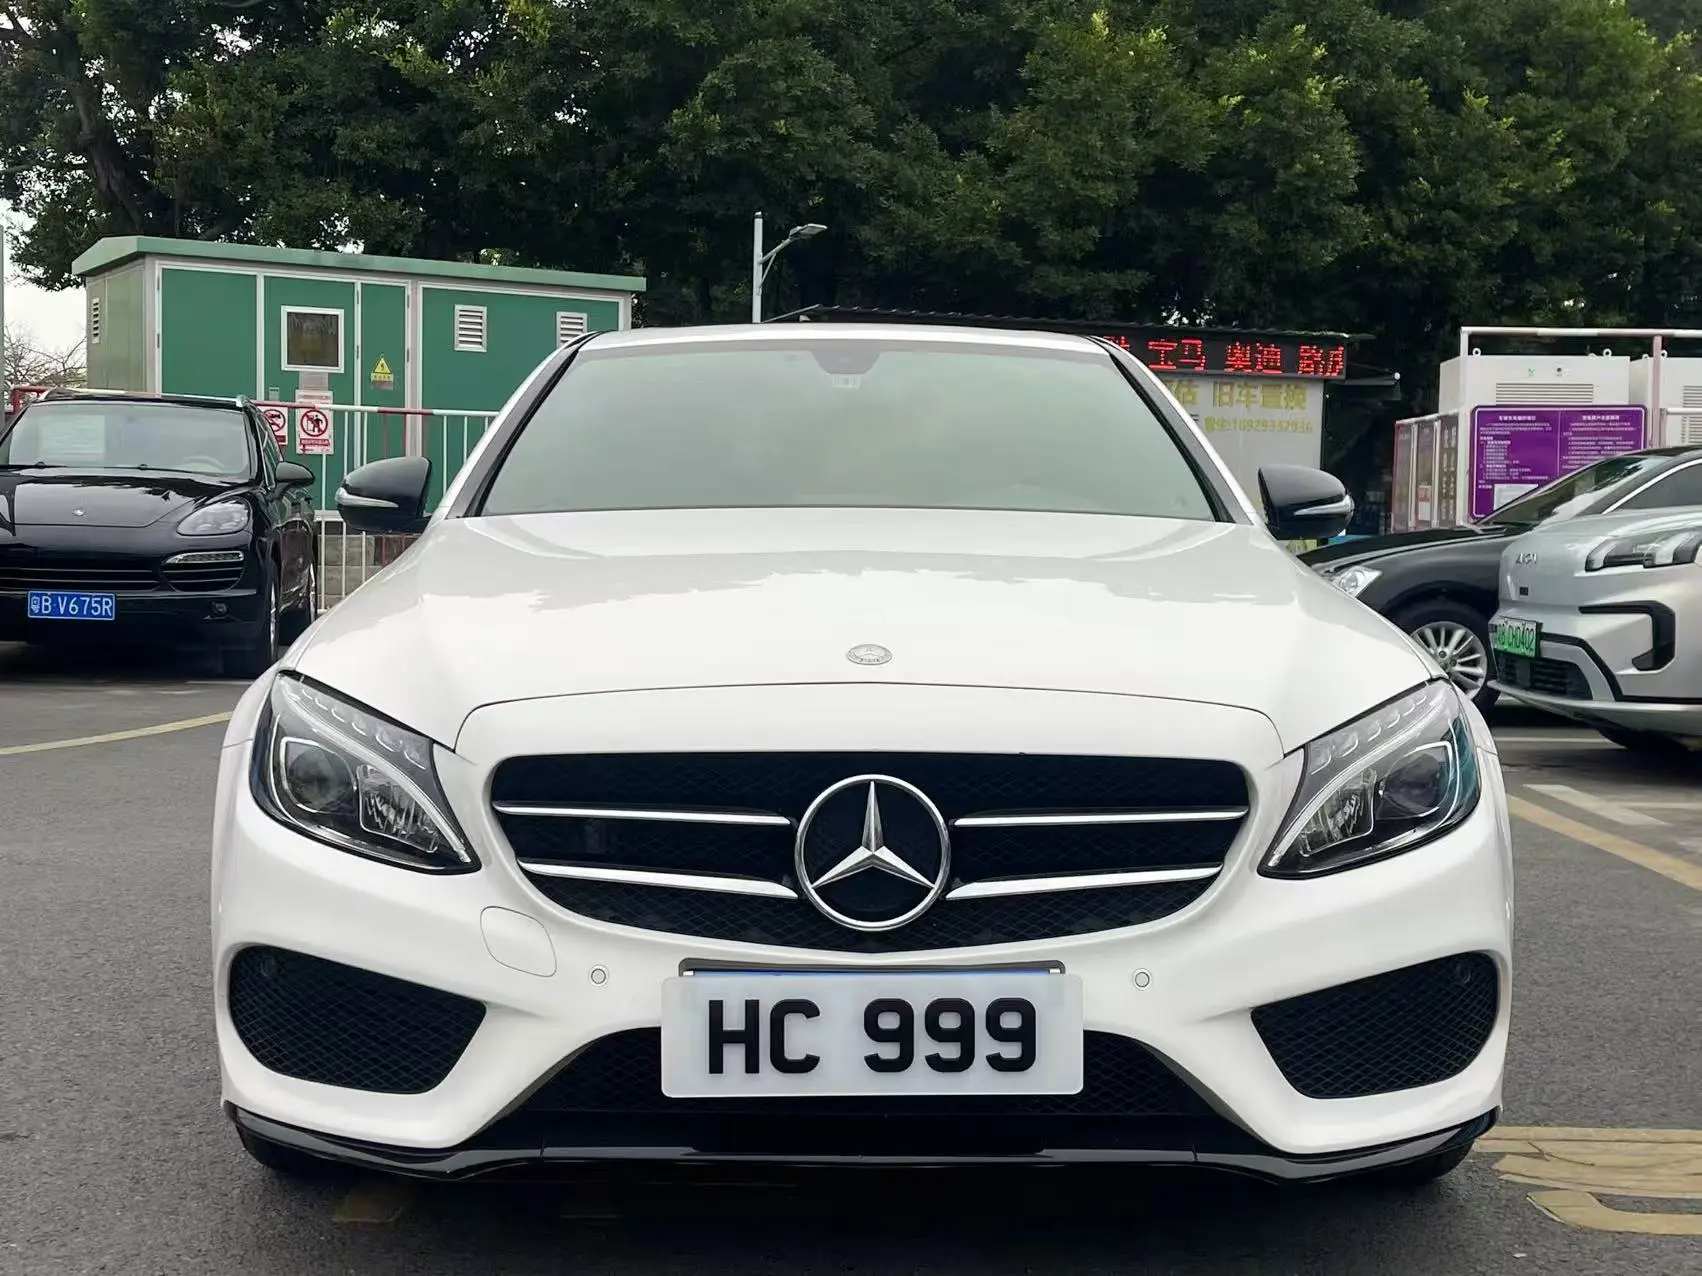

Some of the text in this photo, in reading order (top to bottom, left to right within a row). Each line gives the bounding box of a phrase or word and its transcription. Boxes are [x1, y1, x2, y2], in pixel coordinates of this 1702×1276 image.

[1224, 341, 1282, 374] 奥迪
[708, 997, 1036, 1074] HC 999
